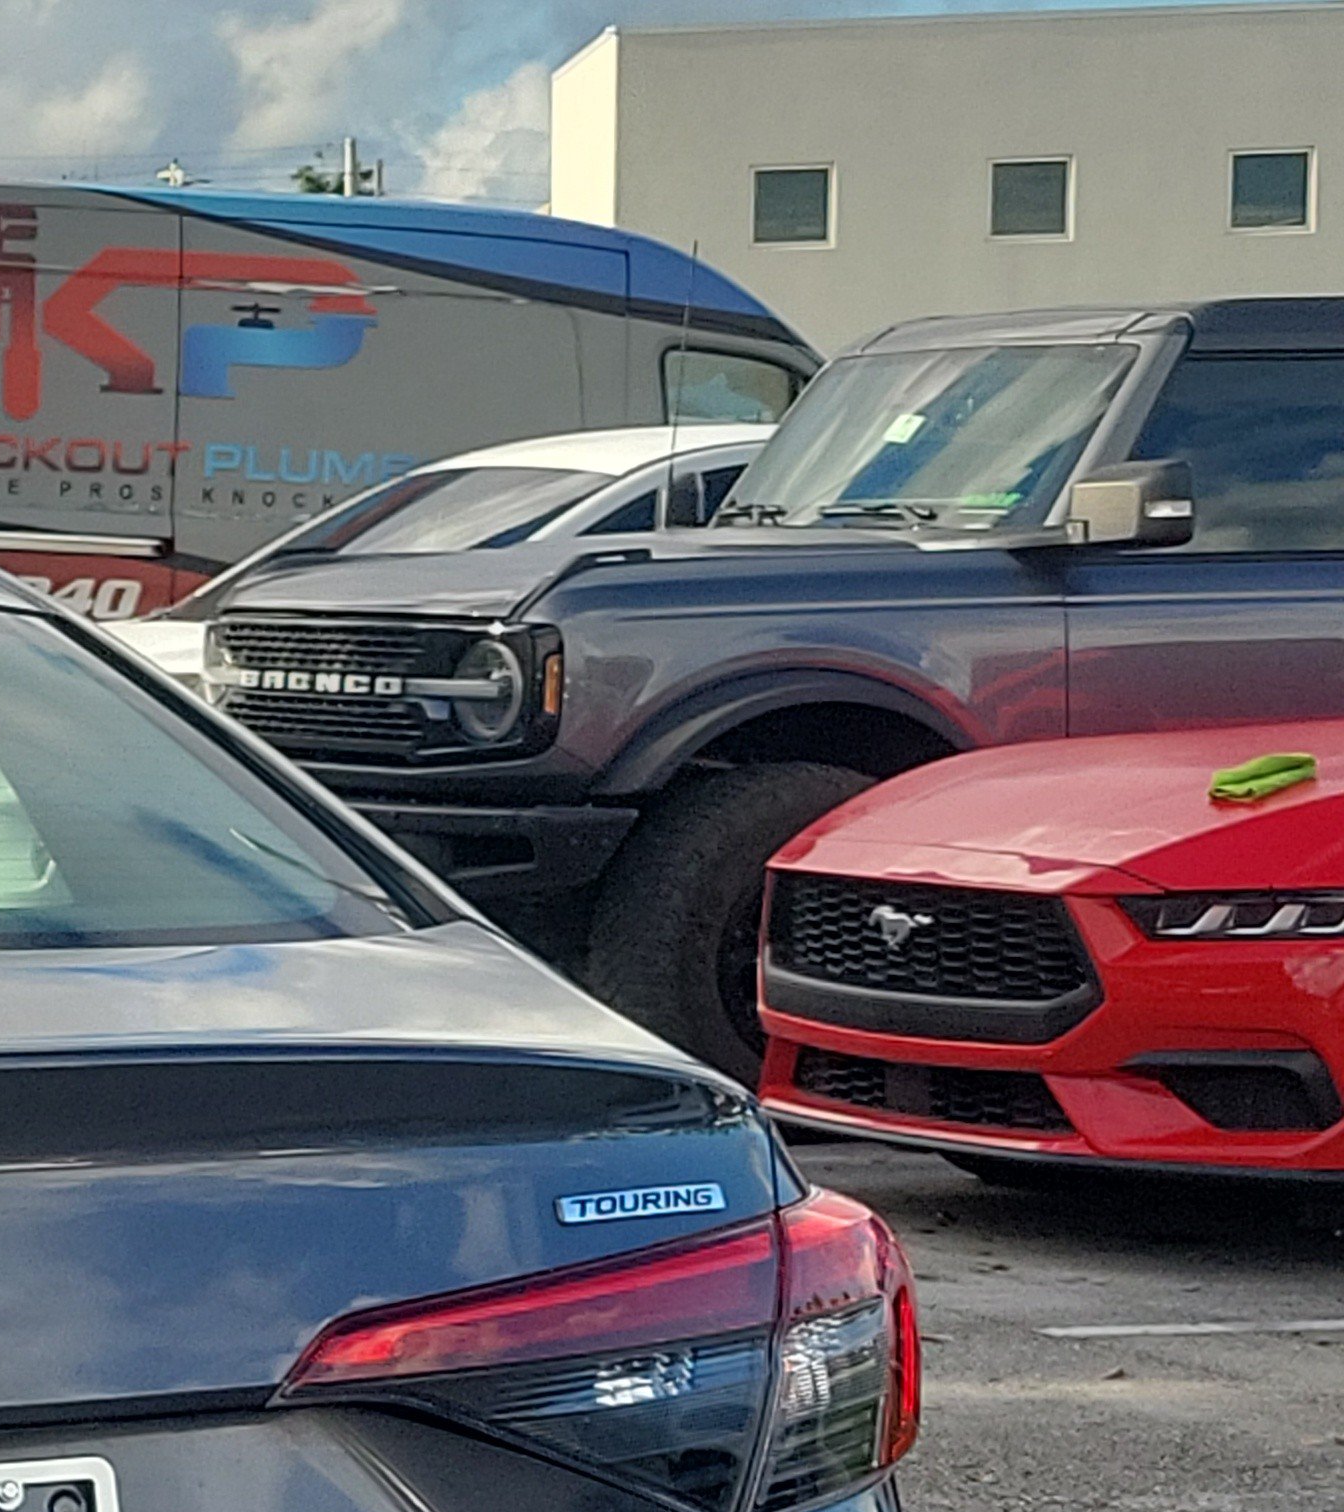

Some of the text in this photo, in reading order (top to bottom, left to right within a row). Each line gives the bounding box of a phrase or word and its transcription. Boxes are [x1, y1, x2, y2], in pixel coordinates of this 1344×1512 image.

[59, 480, 163, 501] PROS
[201, 486, 336, 509] KNOCK
[239, 669, 404, 696] BRONCO
[570, 1187, 713, 1219] TOURING
